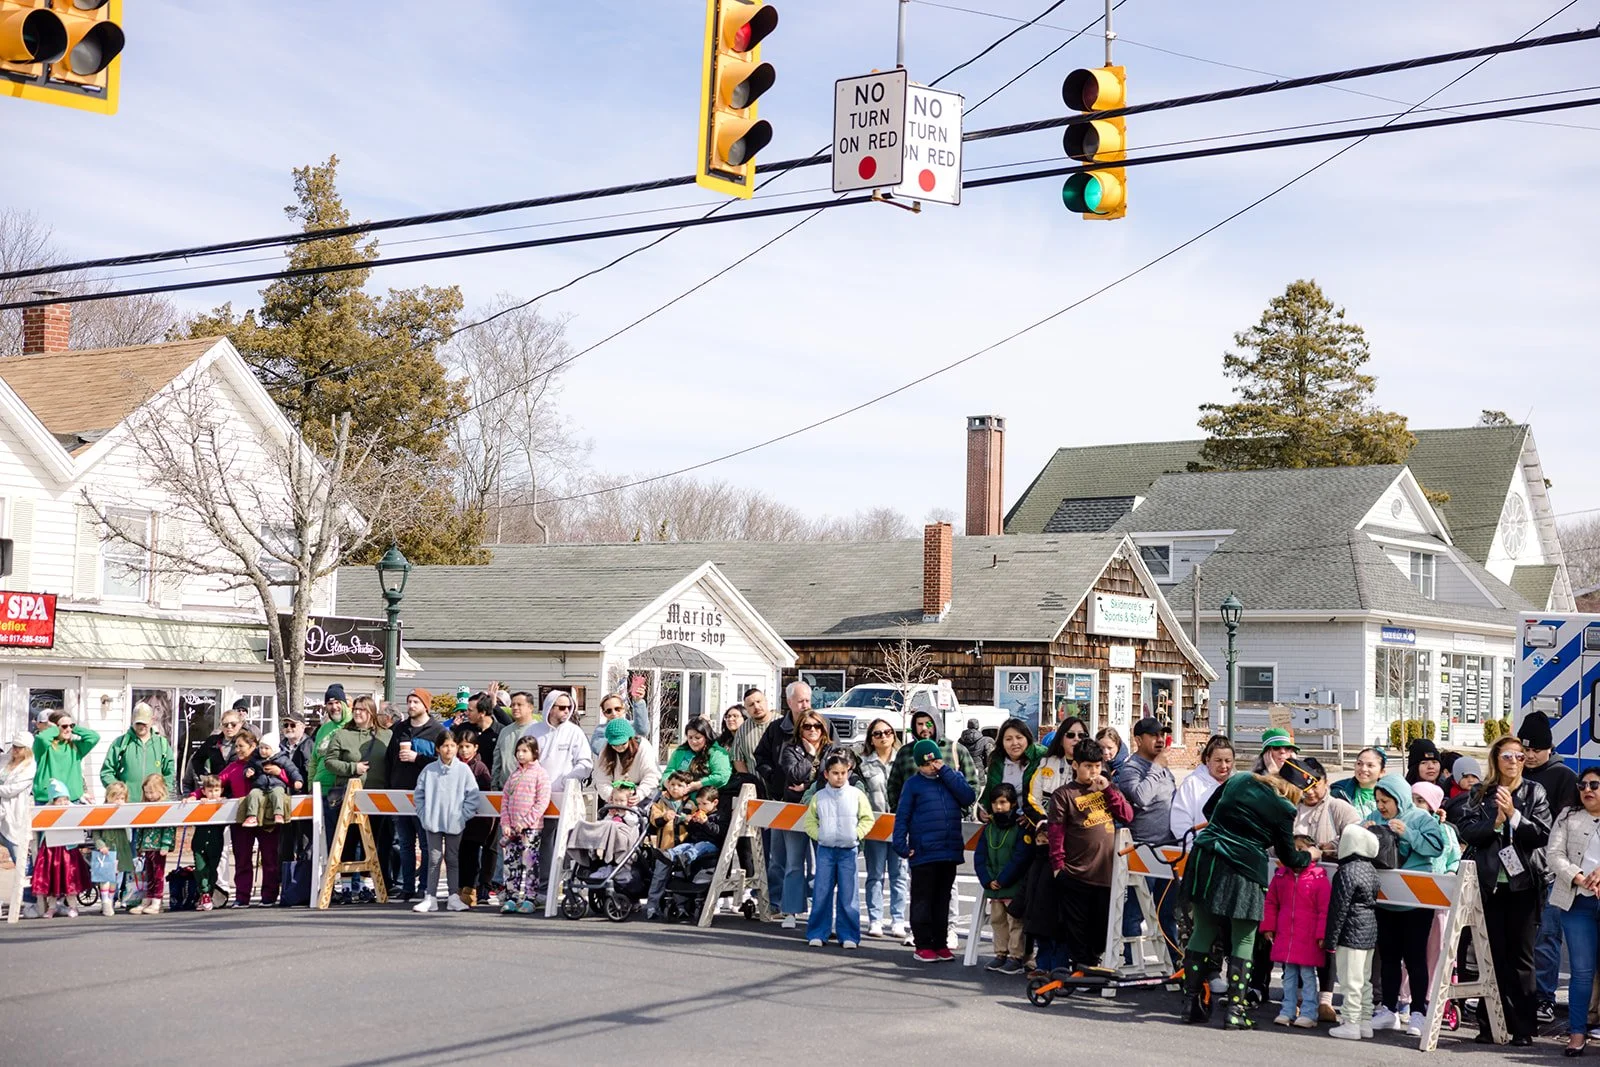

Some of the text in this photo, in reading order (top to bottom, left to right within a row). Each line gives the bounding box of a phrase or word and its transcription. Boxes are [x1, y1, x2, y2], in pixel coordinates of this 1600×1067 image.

[855, 82, 885, 106] NO
[850, 108, 890, 129] TURN
[914, 95, 942, 119] NO
[840, 131, 898, 154] ON RED
[908, 121, 947, 143] TURN
[928, 148, 955, 167] RED
[7, 595, 49, 620] SPA
[666, 602, 722, 627] Mario's
[1110, 598, 1142, 611] Skidmore's
[1104, 610, 1123, 623] Sports
[1130, 612, 1148, 625] Styles
[660, 624, 726, 647] barber shop
